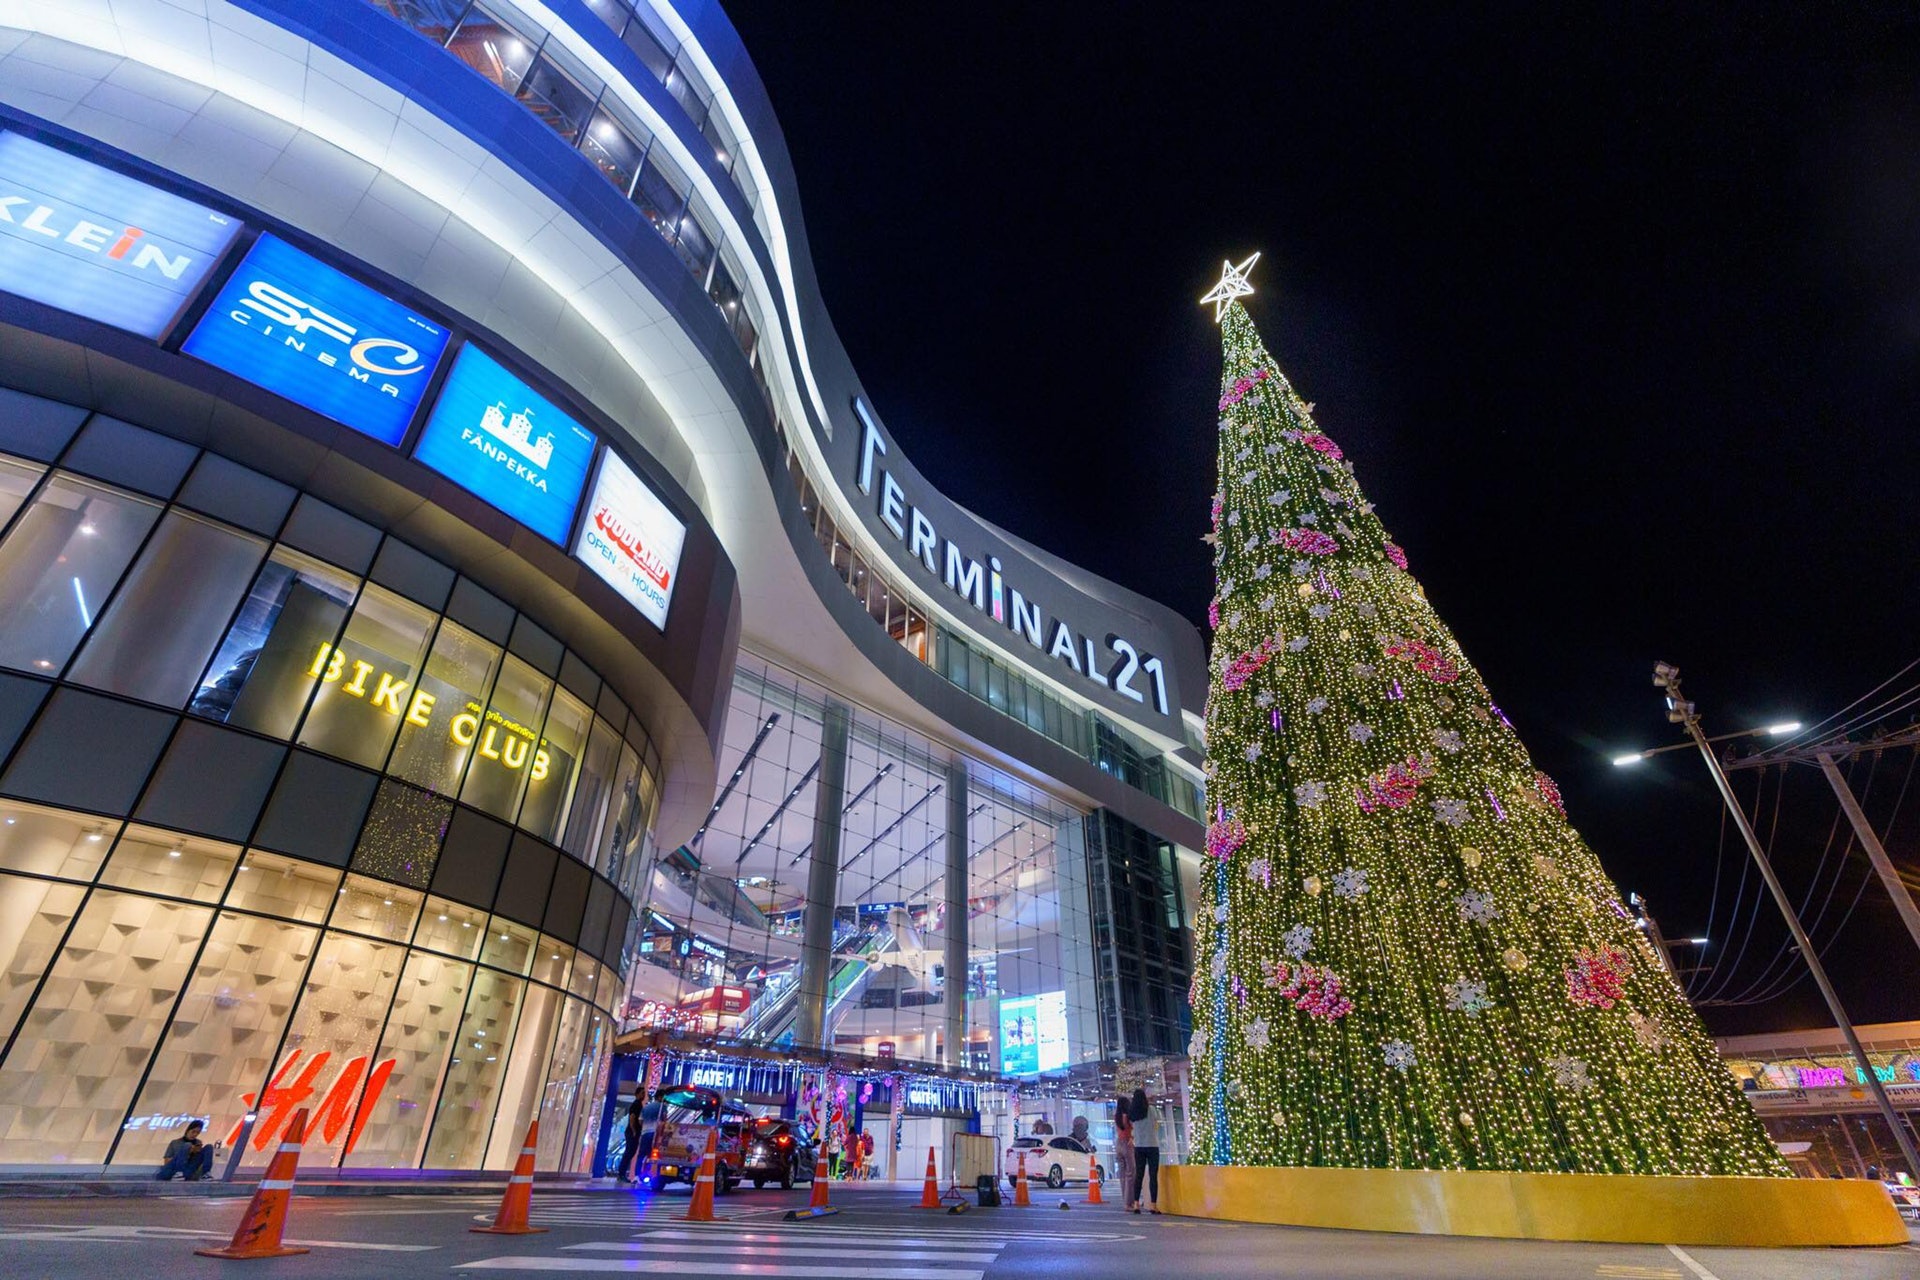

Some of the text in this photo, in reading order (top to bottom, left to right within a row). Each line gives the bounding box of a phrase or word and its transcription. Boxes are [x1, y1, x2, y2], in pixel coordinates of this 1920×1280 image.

[230, 310, 400, 398] CINEMA
[586, 531, 617, 565] OPEN
[631, 572, 666, 610] HOURS
[307, 641, 551, 782] BIKE CLUB
[693, 1068, 734, 1088] GATE 1
